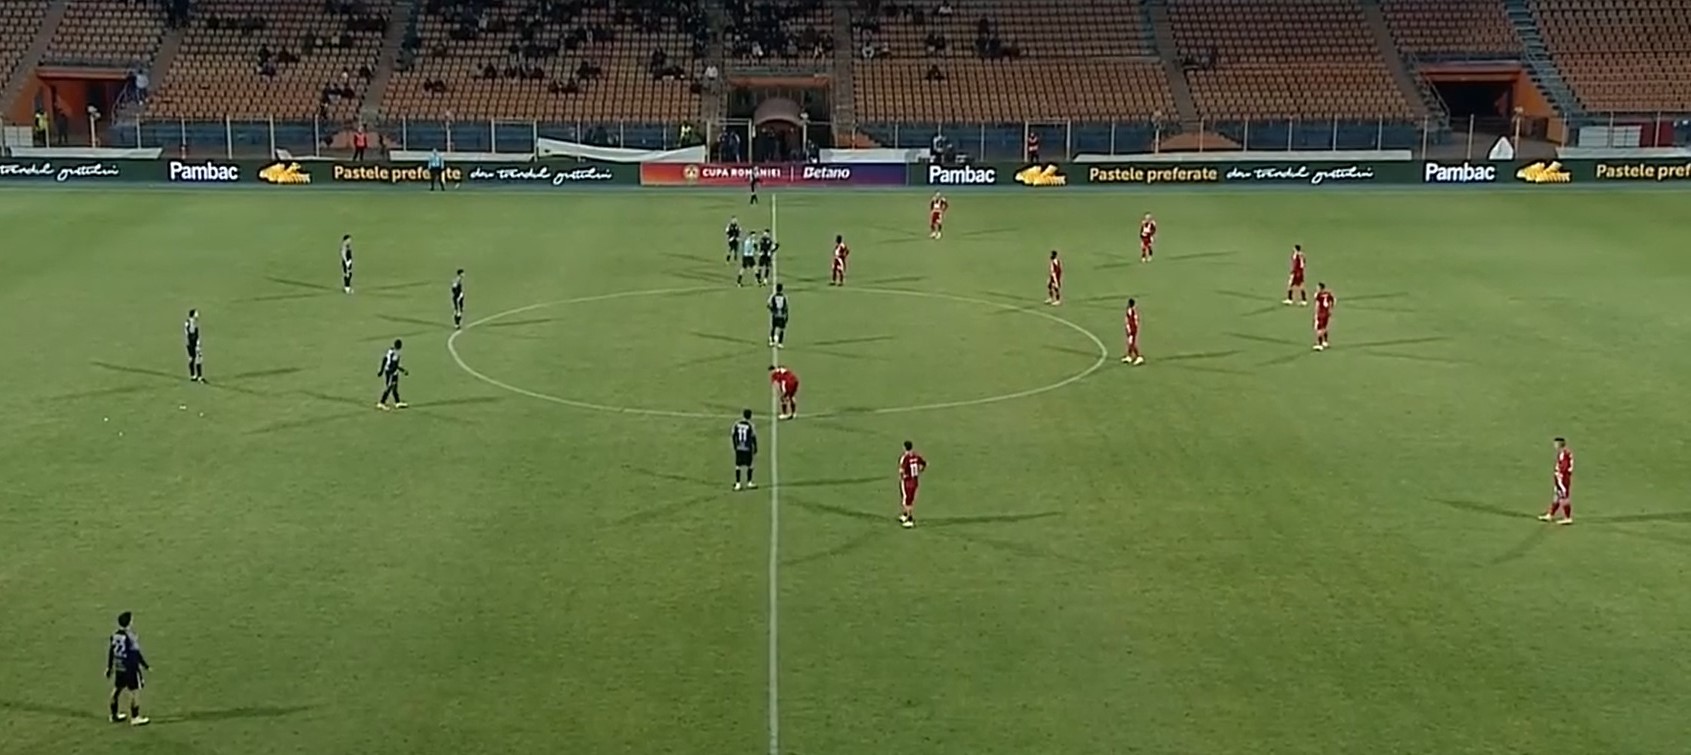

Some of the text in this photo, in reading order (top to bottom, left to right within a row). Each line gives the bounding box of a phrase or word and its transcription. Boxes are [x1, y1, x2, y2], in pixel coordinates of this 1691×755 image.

[169, 161, 239, 181] Pambac
[334, 166, 389, 179] Pastele
[392, 166, 461, 182] prefete
[702, 166, 781, 178] CUPA ROMNIEI
[803, 166, 850, 180] Betano
[929, 165, 995, 183] Pambac
[1090, 167, 1143, 181] Pastele
[1146, 166, 1217, 184] preferate
[1425, 161, 1496, 181] Pambac
[1596, 163, 1655, 178] Pastele
[737, 428, 748, 441] 11
